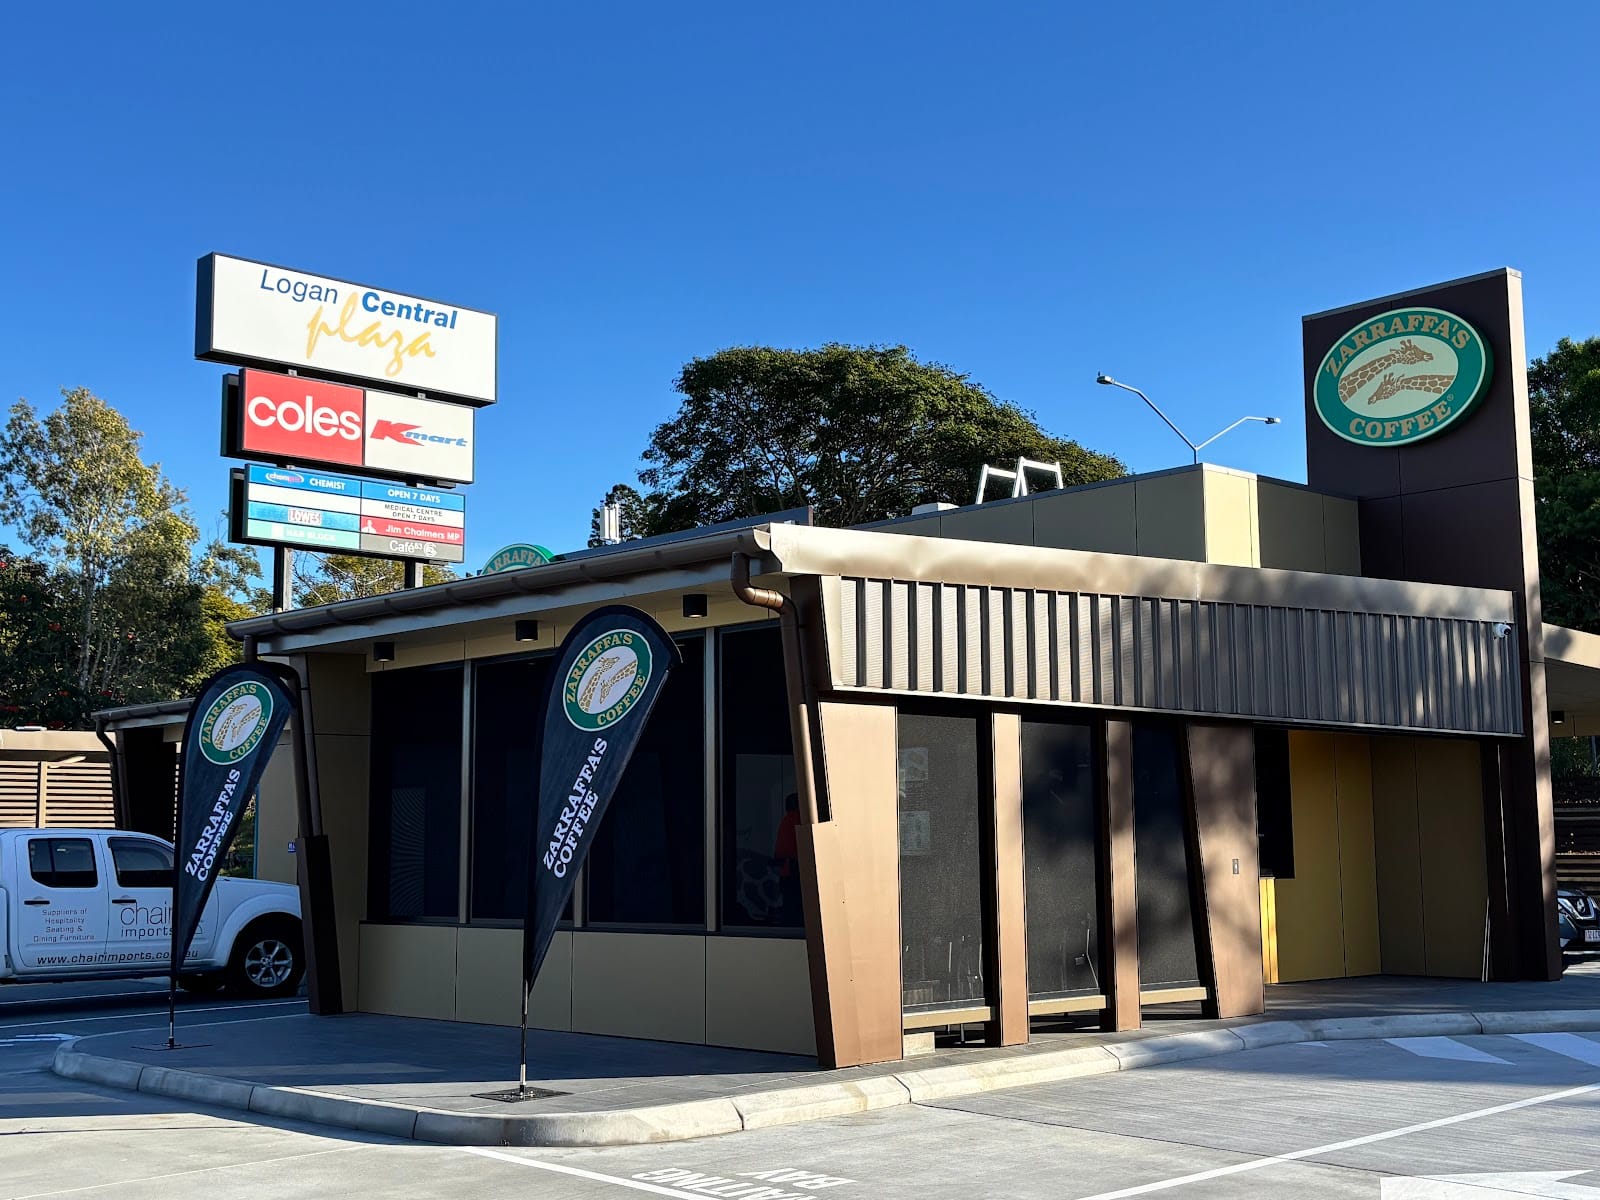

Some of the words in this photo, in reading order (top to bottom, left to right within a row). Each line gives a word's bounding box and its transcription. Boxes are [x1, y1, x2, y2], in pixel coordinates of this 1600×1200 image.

[260, 269, 338, 304] Logan
[362, 291, 458, 329] Central
[306, 292, 436, 377] plaza
[1326, 314, 1471, 378] ZARRAFFA'S
[247, 395, 361, 441] coles
[370, 419, 468, 447] Kmart
[1349, 400, 1452, 439] COFFEE
[309, 478, 346, 490] CHEMIST
[388, 489, 410, 499] OPEN
[412, 492, 418, 500] 7
[420, 494, 441, 503] DAYS
[289, 509, 321, 524] LOWES
[384, 504, 414, 513] MEDICAL
[416, 508, 443, 517] CENTRE
[392, 511, 411, 519] OPEN
[418, 514, 435, 522] DAYS
[386, 525, 402, 534] Jim
[404, 527, 445, 539] Chalmers
[447, 532, 460, 540] MP
[566, 632, 633, 703] ZARRAFFA'S
[202, 684, 257, 744] ZARRAFFA'S
[596, 674, 646, 726] COFFEE
[229, 716, 267, 759] COFFEE
[185, 768, 241, 877] ZARRAFFA'S
[543, 737, 608, 871] ZARRAFFA'S
[197, 810, 234, 882] COFFEE
[554, 790, 599, 878] COFFEE
[120, 900, 173, 926] chair
[121, 926, 173, 941] imports
[736, 1167, 858, 1190] BAY
